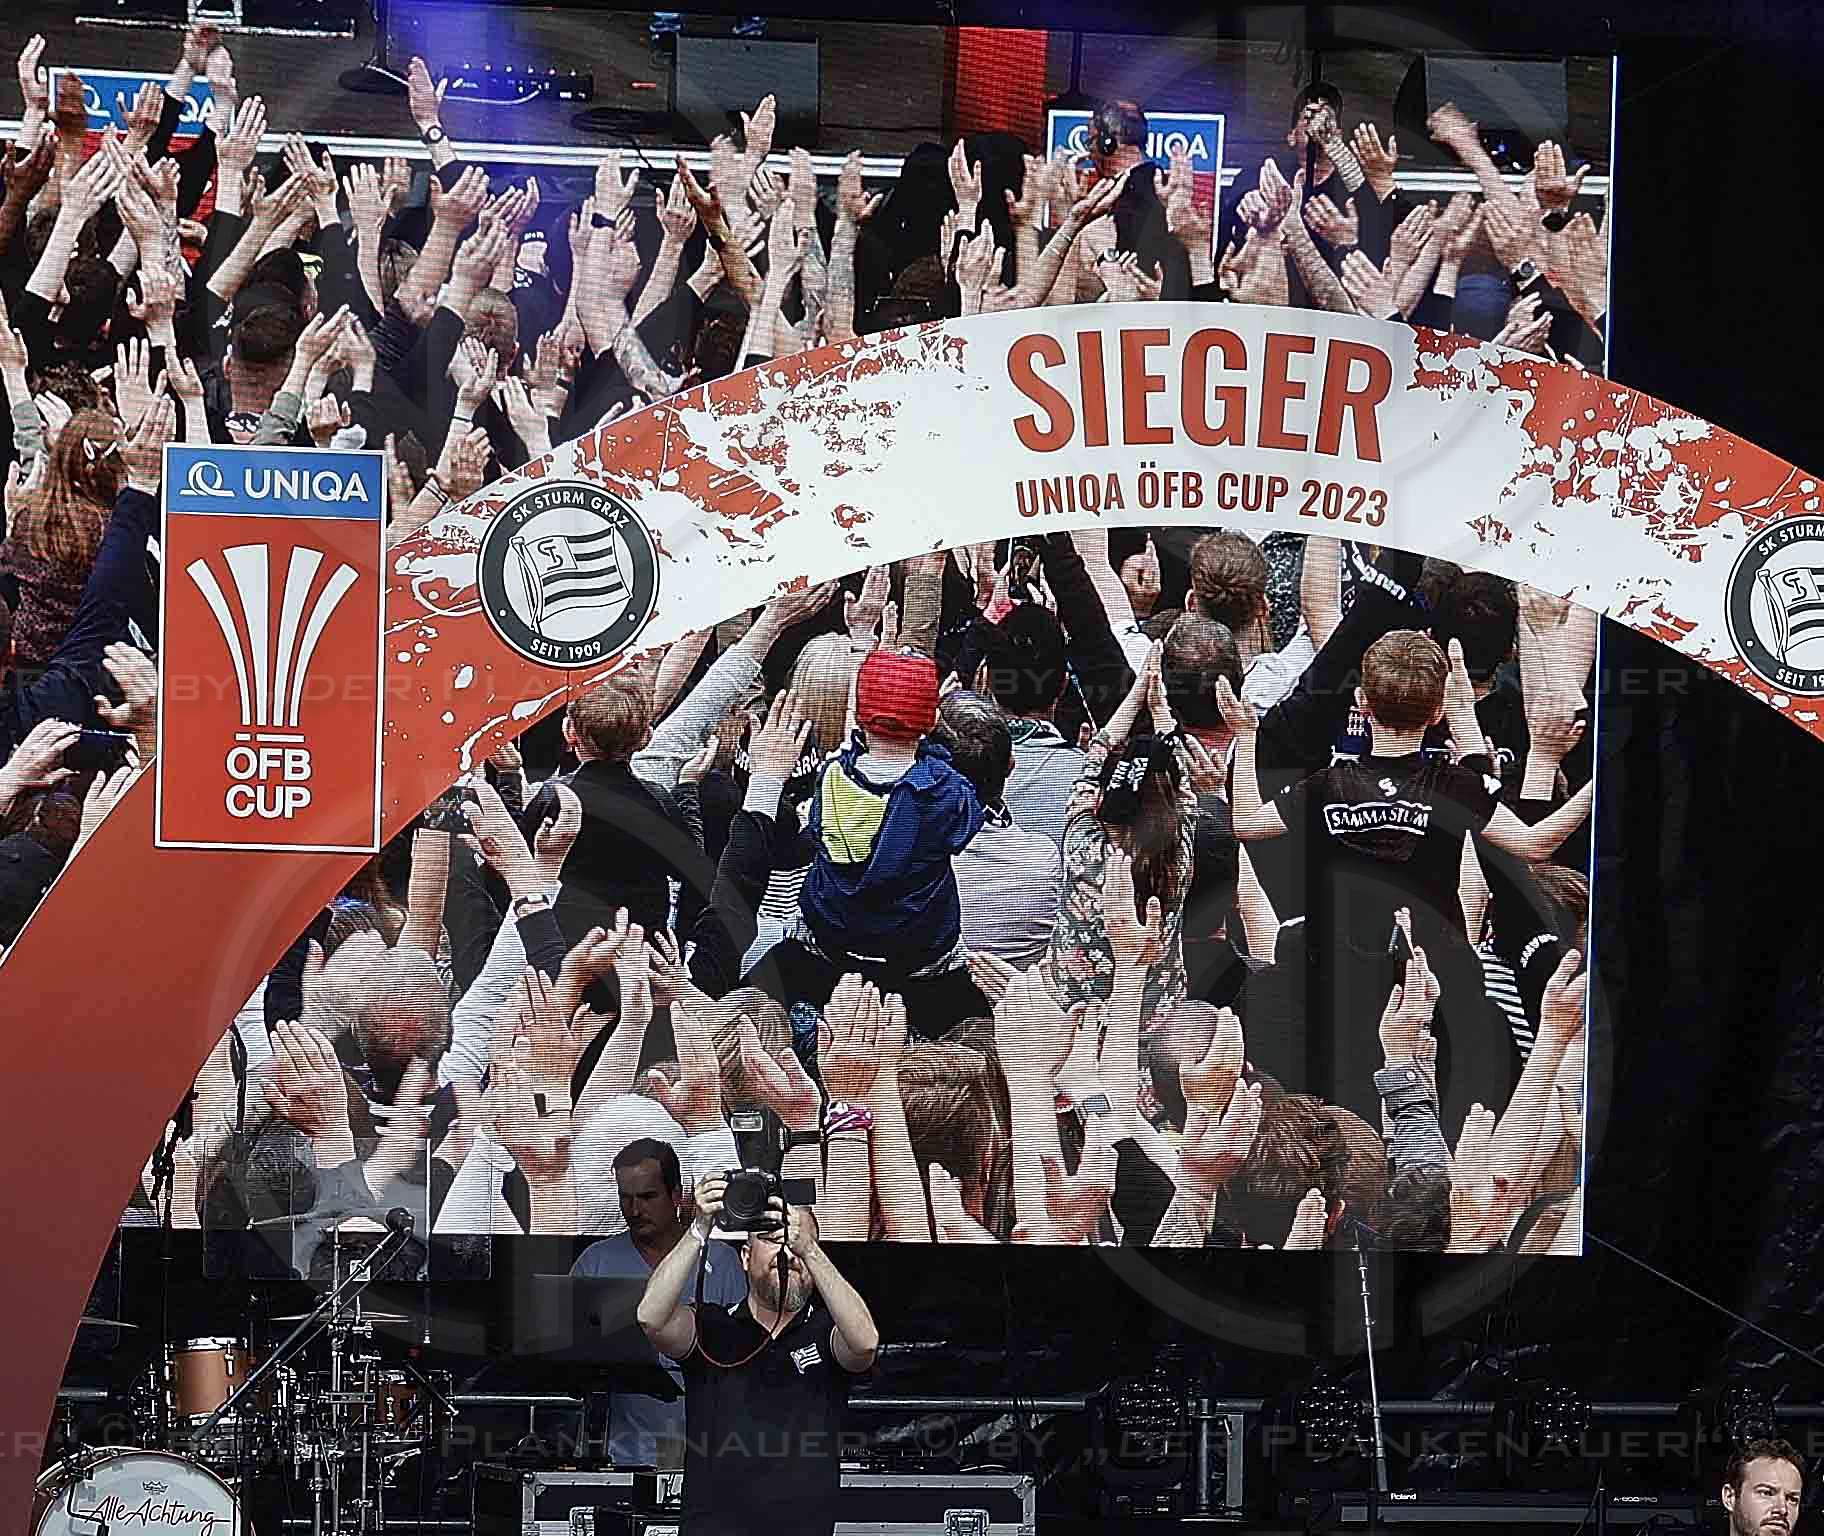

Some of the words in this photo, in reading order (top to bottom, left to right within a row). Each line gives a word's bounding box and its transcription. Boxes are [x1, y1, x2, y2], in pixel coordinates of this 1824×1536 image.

[1006, 327, 1393, 463] SIEGER
[243, 468, 369, 502] UNIQA
[1015, 472, 1124, 517] UNIQA
[1137, 461, 1204, 510] ÖFB
[1217, 473, 1289, 512] CUP
[1299, 479, 1388, 527] 2023
[512, 503, 533, 523] SK
[534, 491, 585, 510] STURM
[590, 497, 631, 529] GRAZ
[1758, 536, 1778, 556] SK
[530, 639, 562, 659] SEIT
[568, 641, 602, 659] 1909
[1775, 668, 1806, 687] SEIT
[225, 783, 312, 819] CUP
[1390, 1492, 1417, 1501] Roland
